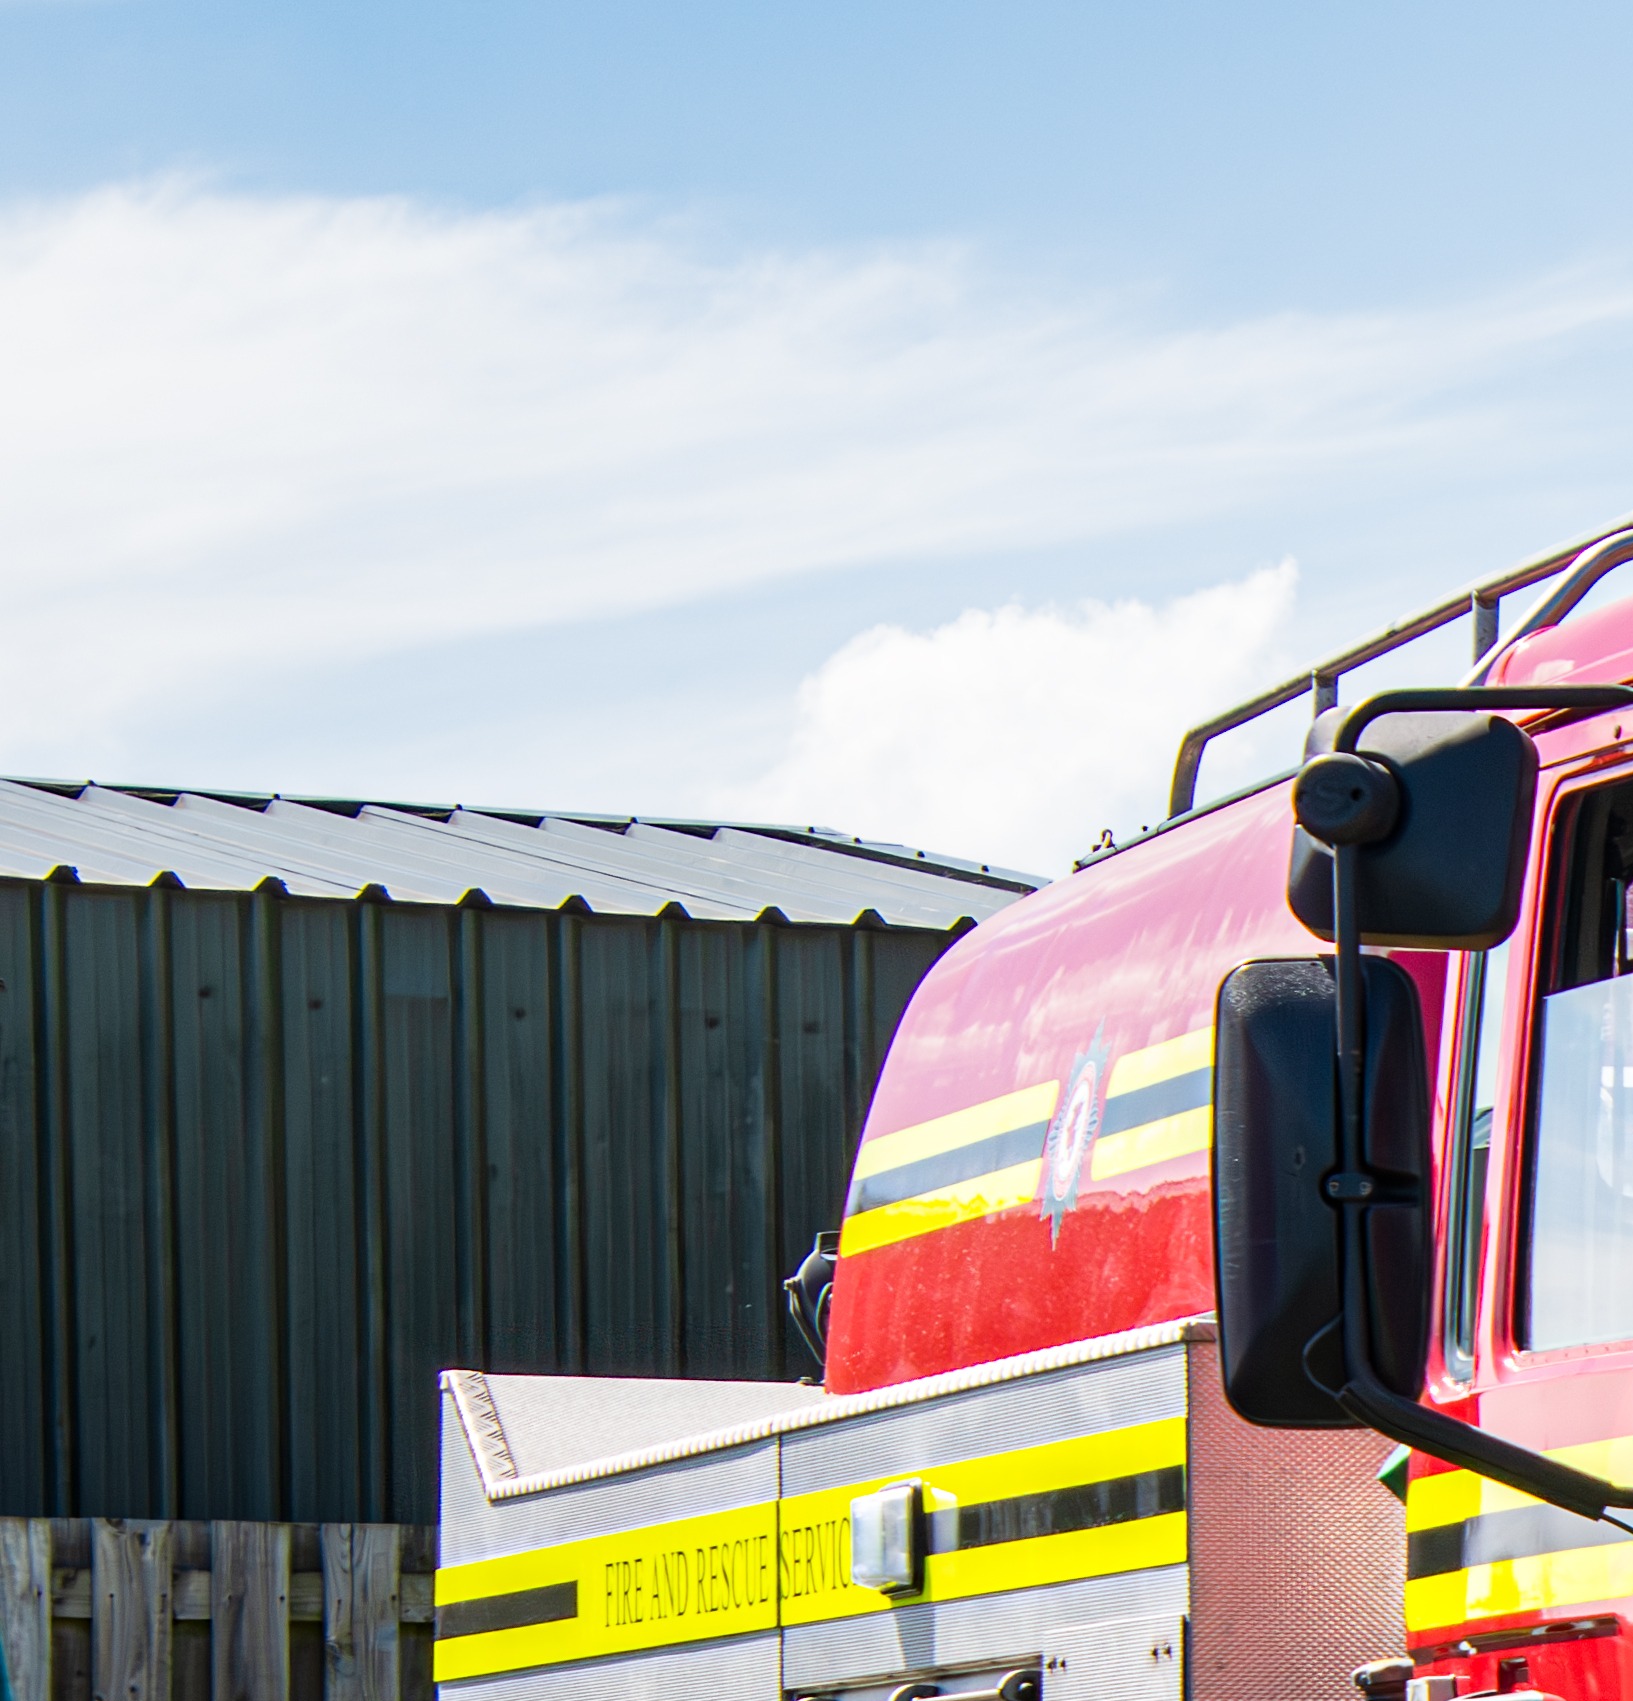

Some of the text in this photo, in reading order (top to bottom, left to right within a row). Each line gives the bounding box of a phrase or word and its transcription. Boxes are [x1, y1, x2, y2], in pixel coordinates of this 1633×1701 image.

[605, 1517, 857, 1628] FIRE AND RESCUE SERVIC
